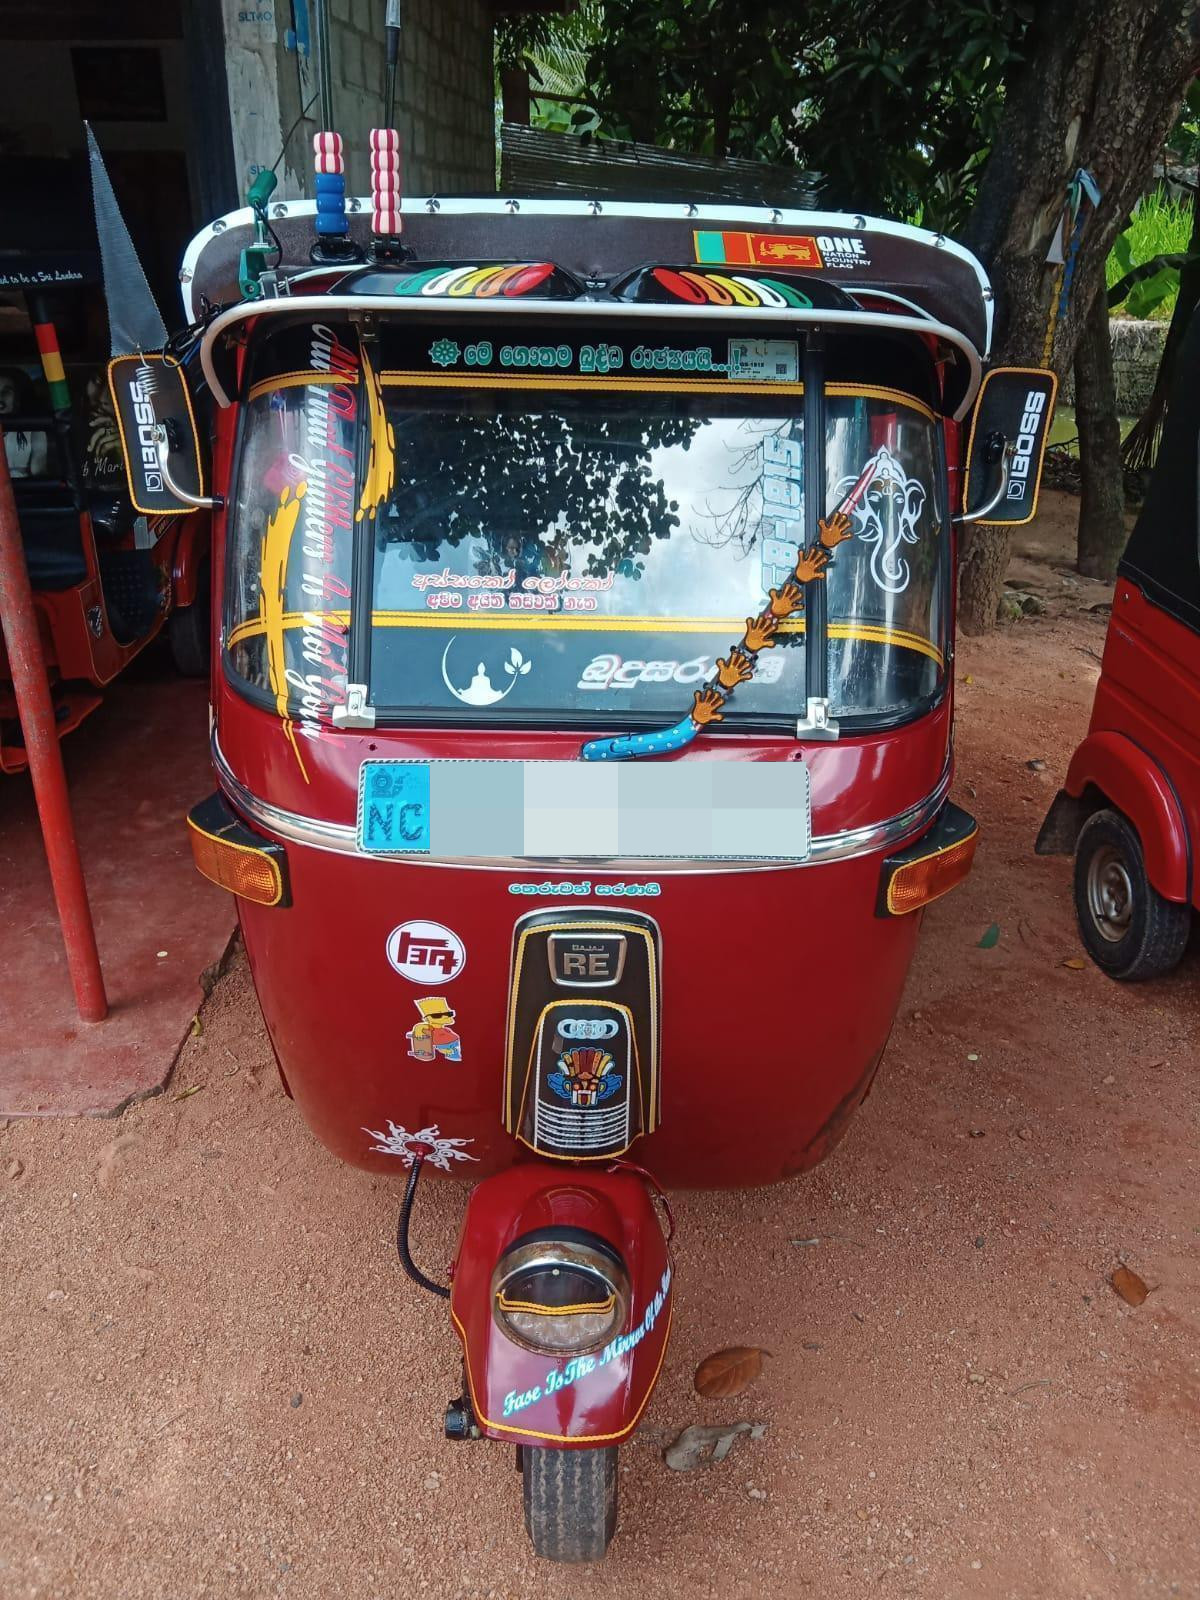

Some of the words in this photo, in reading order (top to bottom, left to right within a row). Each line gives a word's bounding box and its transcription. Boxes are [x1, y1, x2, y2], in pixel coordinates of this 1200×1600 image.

[816, 236, 866, 255] ONE
[823, 251, 860, 259] NATION
[824, 256, 872, 266] COUNTRY
[463, 341, 493, 366] මේ
[1011, 391, 1046, 478] BOSS
[368, 803, 424, 841] NC
[563, 952, 610, 976] RE
[564, 1356, 597, 1386] The
